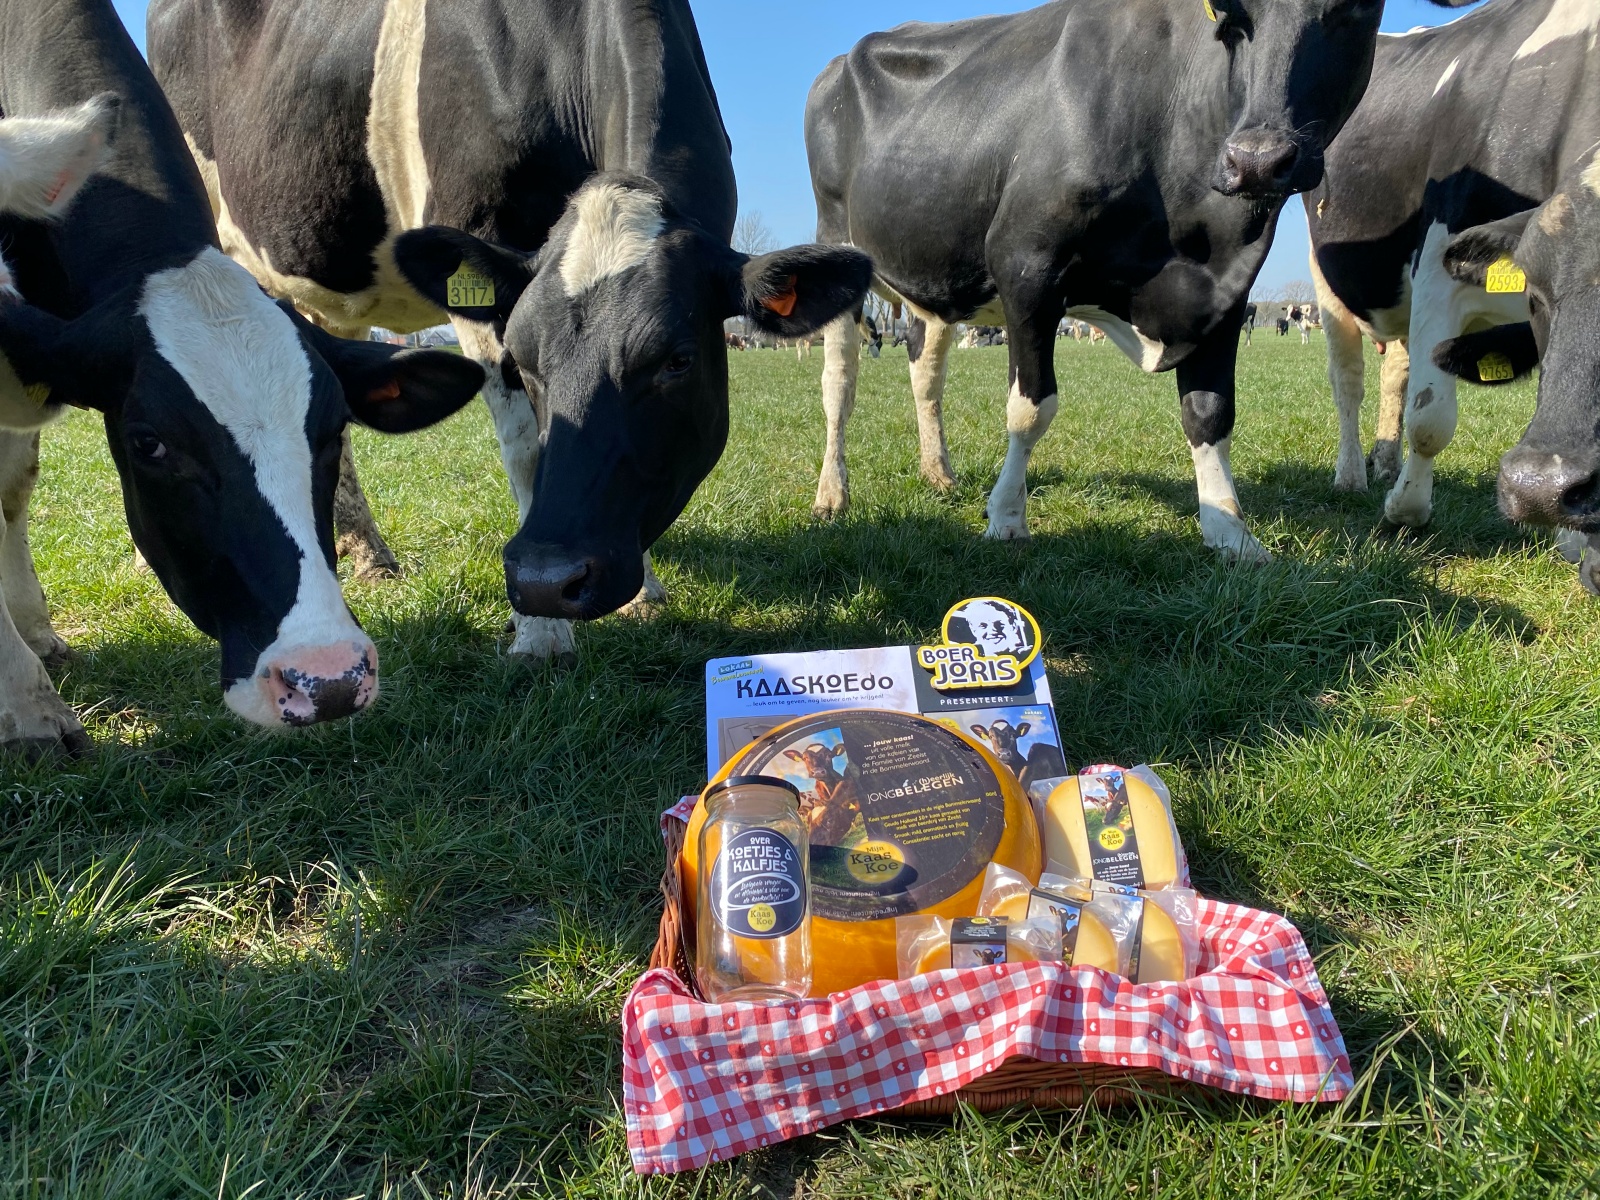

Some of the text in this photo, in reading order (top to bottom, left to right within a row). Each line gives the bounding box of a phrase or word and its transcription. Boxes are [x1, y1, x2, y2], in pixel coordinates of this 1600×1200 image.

[1489, 274, 1519, 291] 2593
[451, 287, 488, 305] 3117
[1482, 364, 1509, 380] 2765
[923, 647, 974, 664] BOER
[719, 661, 752, 673] LOKAAL
[936, 659, 1016, 685] JORIS
[786, 699, 807, 707] geven,
[940, 696, 1014, 706] PRESENTEERT:
[873, 739, 892, 748] jouw
[894, 734, 914, 743] kaas!
[881, 744, 894, 752] volle
[872, 758, 894, 767] Familie
[895, 755, 906, 763] van
[908, 751, 927, 761] Zeelst
[919, 771, 956, 786] (h)eerlijk
[867, 775, 964, 804] JONGBELEGEN
[900, 816, 918, 825] Holland
[750, 837, 771, 845] OVER
[728, 846, 793, 861] KOETJES &
[850, 852, 892, 865] Kaas
[733, 859, 788, 873] KALFJES
[864, 861, 899, 874] Koe
[750, 910, 771, 918] Kaas
[756, 918, 773, 926] Koe
